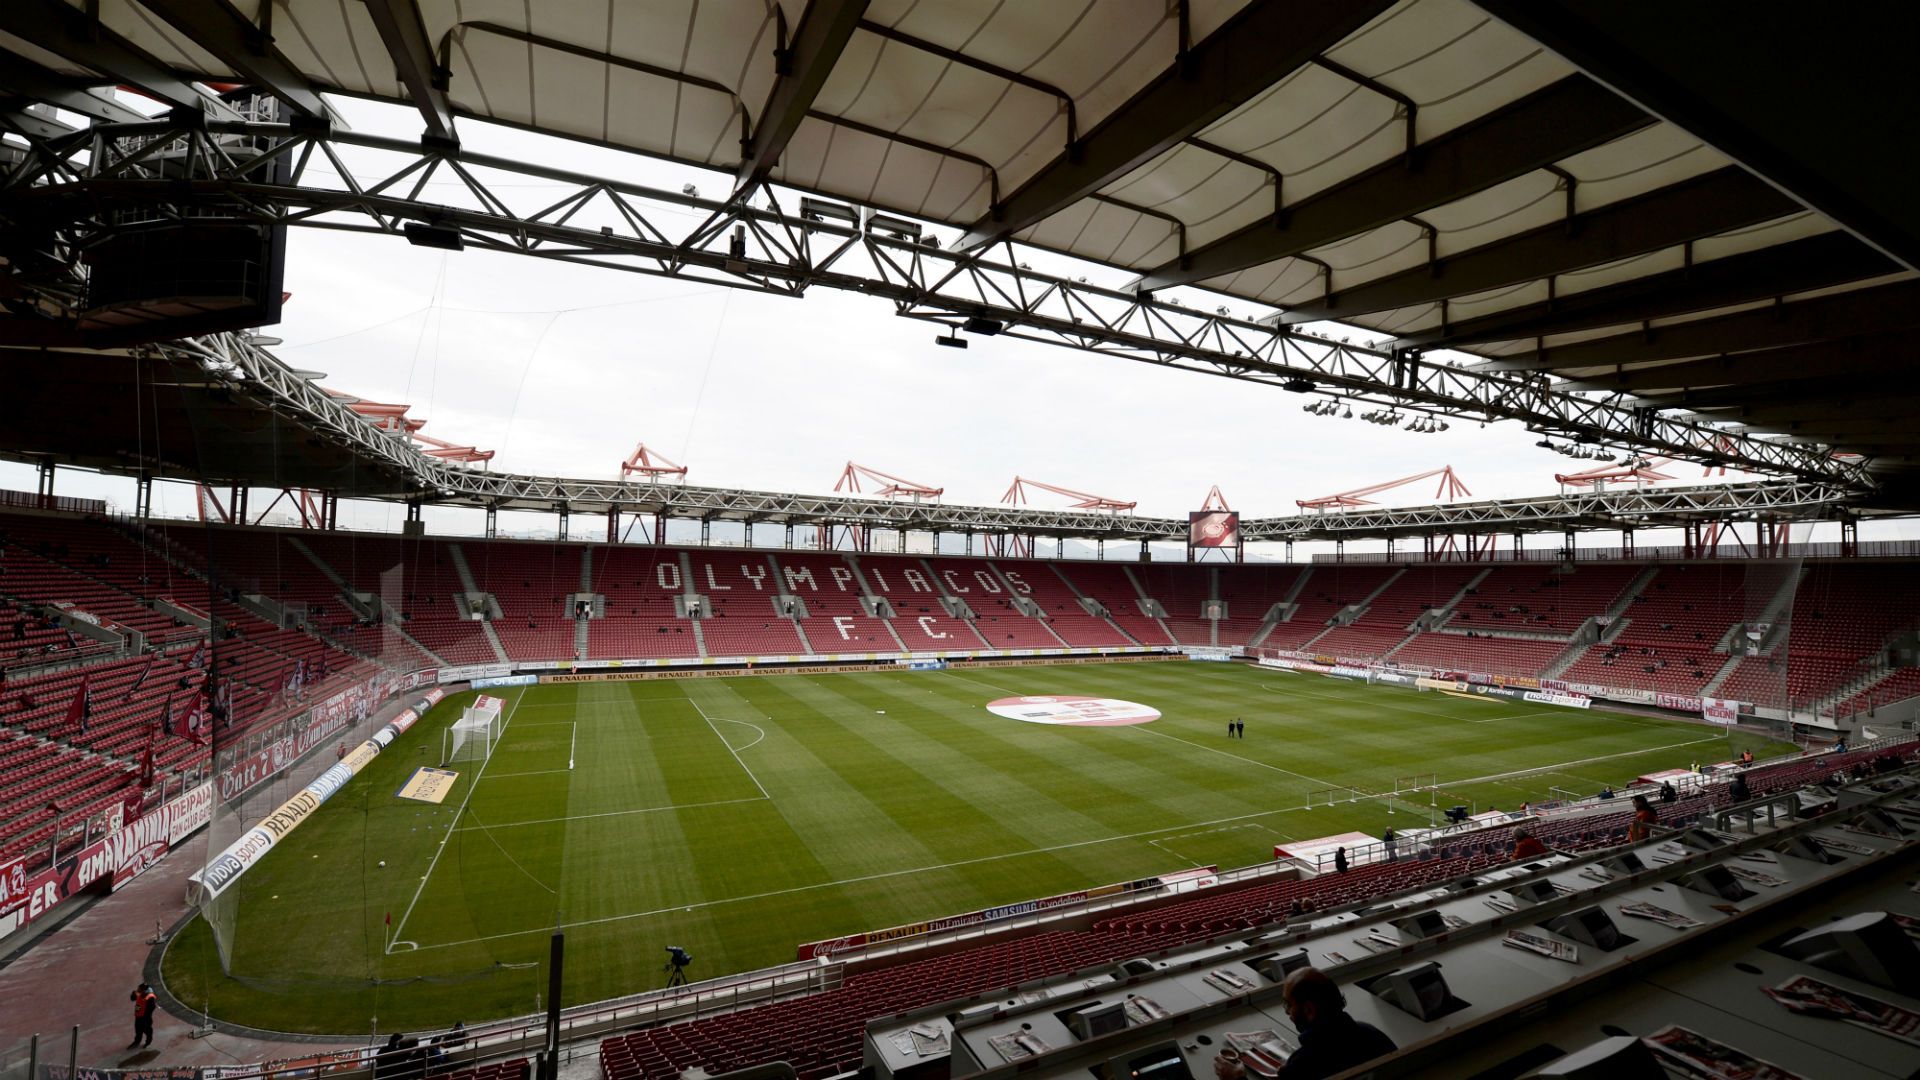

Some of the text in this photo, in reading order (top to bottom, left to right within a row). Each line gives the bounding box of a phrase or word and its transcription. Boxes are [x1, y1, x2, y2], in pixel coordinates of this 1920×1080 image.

[657, 562, 1032, 593] OLYMPIACOS
[833, 616, 954, 640] F. C.
[657, 671, 694, 679] RENAULT
[839, 665, 869, 673] RENAULT
[1530, 692, 1552, 701] nova
[1554, 694, 1582, 705] sports
[1657, 694, 1701, 710] ASTROS
[308, 763, 353, 800] SAMSUNG
[264, 792, 316, 836] RENAULT
[209, 835, 266, 886] nova sports
[946, 912, 984, 928] Emirates
[985, 902, 1037, 922] SAMSUNG
